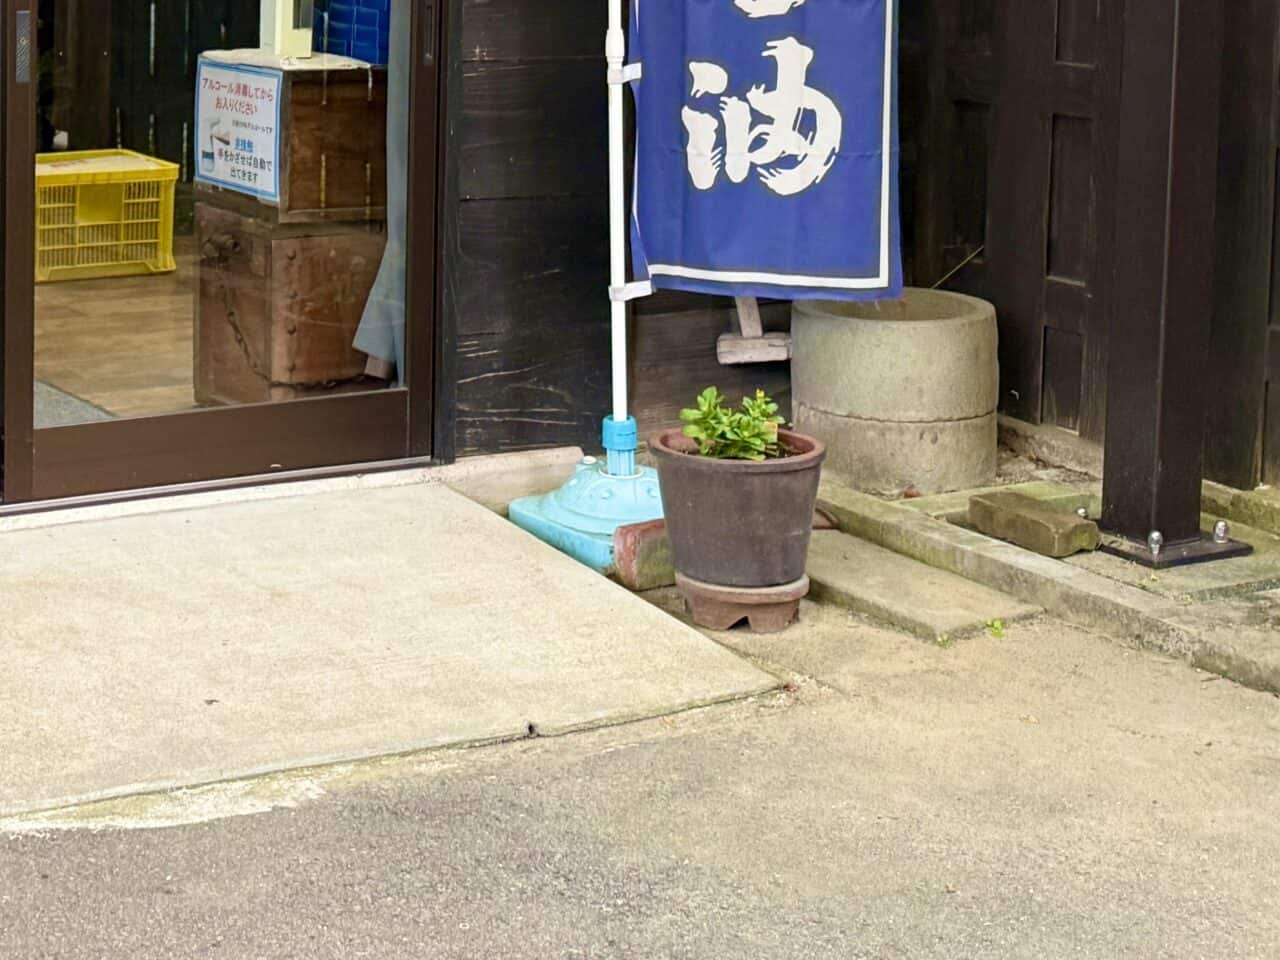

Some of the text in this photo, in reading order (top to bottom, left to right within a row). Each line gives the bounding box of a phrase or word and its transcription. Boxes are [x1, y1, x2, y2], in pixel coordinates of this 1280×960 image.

[202, 78, 273, 102] アルコール消毒してから
[215, 96, 258, 115] お入りください
